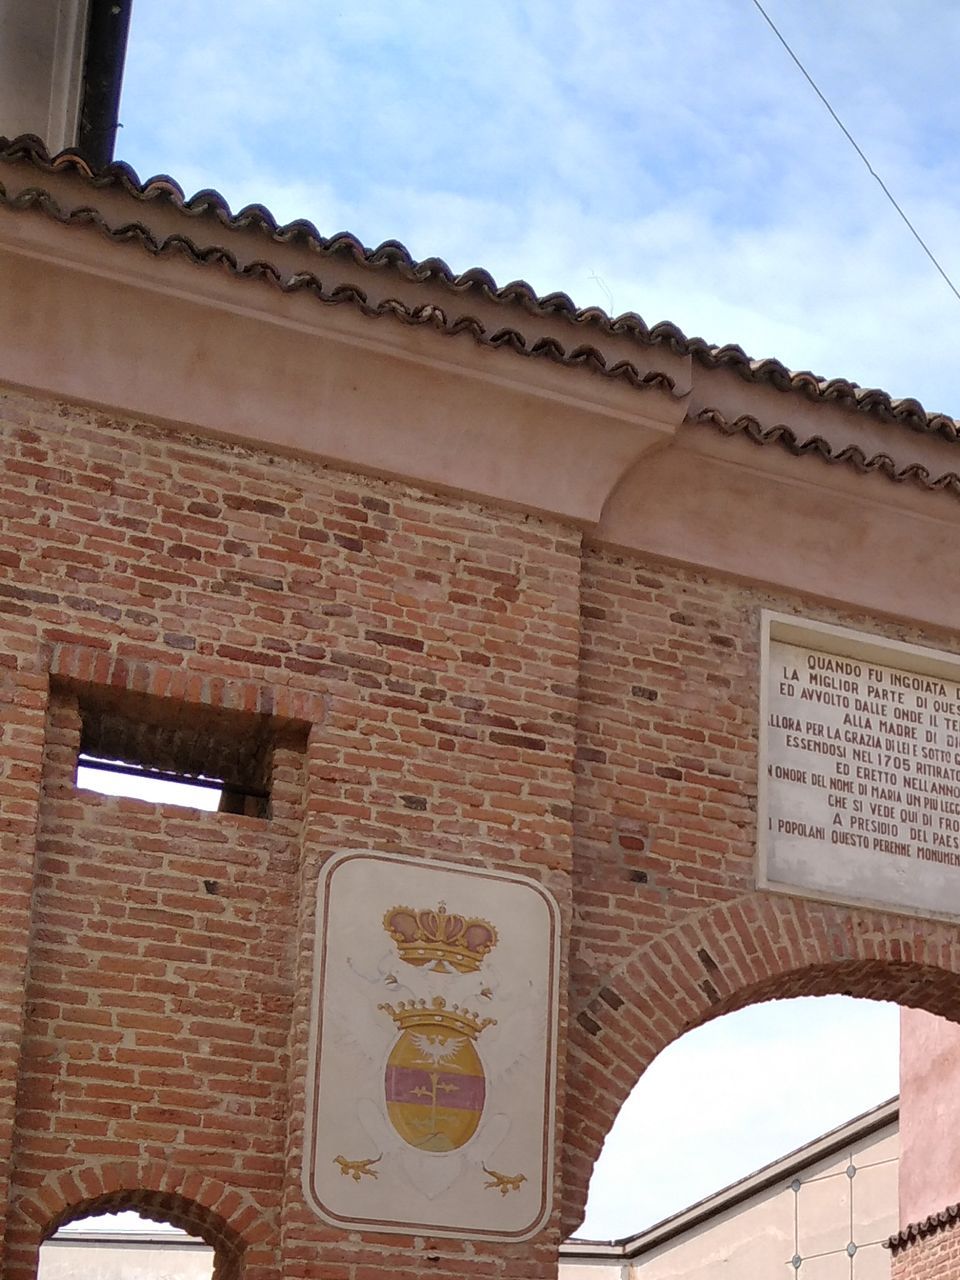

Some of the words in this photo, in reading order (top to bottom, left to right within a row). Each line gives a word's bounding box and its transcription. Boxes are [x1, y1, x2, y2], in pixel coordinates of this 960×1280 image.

[783, 666, 799, 681] LA
[809, 673, 859, 695] MIGLIOR
[867, 685, 905, 704] PARTE
[916, 696, 927, 709] DI
[807, 654, 861, 677] QUANDO
[868, 668, 883, 682] FU
[890, 673, 947, 697] INGOIATA
[780, 682, 794, 697] ED
[800, 688, 849, 709] AVVOLTO
[855, 699, 887, 717] DALLE
[894, 707, 923, 724] ONDE
[929, 715, 938, 727] IL
[768, 714, 802, 733] LLORA
[806, 721, 824, 737] PER
[827, 726, 841, 741] LA
[845, 730, 882, 749] GRAZIA
[913, 744, 918, 757] E
[921, 747, 951, 763] SOTTO
[843, 713, 872, 730] ALLA
[880, 720, 917, 740] MADRE
[926, 730, 937, 744] DI
[786, 734, 846, 758] ESSENDOSI
[853, 749, 873, 764] NEL
[878, 754, 911, 772] 1705
[775, 765, 807, 784] ONORE
[811, 773, 827, 788] DEL
[830, 777, 854, 793] NOME
[858, 783, 868, 796] DI
[871, 786, 902, 803] MARIA
[906, 793, 921, 807] UN
[836, 762, 850, 776] ED
[856, 766, 897, 786] ERETTO
[828, 794, 847, 809] CHE
[853, 799, 863, 812] SI
[869, 802, 895, 819] VEDE
[900, 808, 918, 823] QUI
[923, 814, 932, 827] DI
[833, 812, 843, 826] A
[850, 815, 898, 837] PRESIDIO
[910, 828, 928, 843] DEL
[778, 819, 825, 840] POPOLANI
[831, 830, 869, 849] QUESTO
[873, 838, 911, 857] PERENNE
